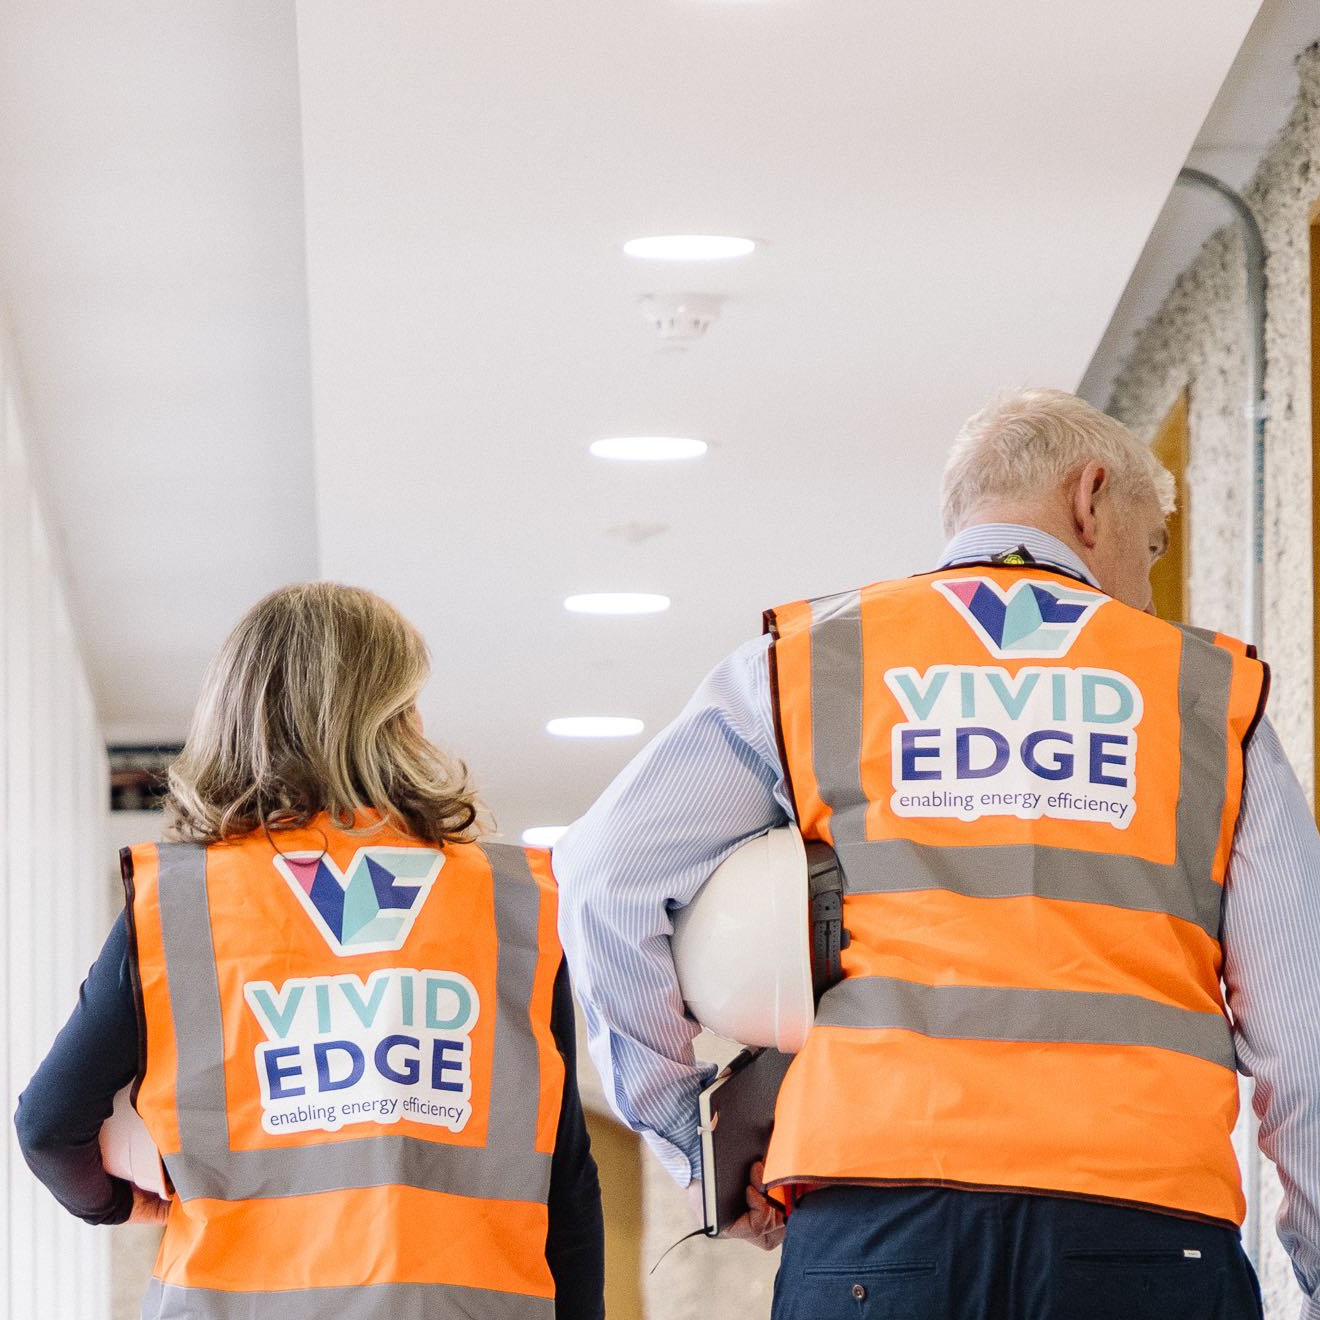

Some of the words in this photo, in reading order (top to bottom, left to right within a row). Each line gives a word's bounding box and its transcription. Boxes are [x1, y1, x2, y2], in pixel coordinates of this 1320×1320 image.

[894, 671, 1135, 723] VIVID
[901, 728, 1129, 788] EDGE
[899, 790, 974, 810] enabling
[981, 792, 1041, 809] energy
[1047, 792, 1128, 818] efficiency
[253, 975, 472, 1038] VIVID
[263, 1034, 465, 1100] EDGE
[270, 1102, 336, 1126] enabling
[341, 1097, 398, 1116] energy
[402, 1096, 464, 1123] efficiency
